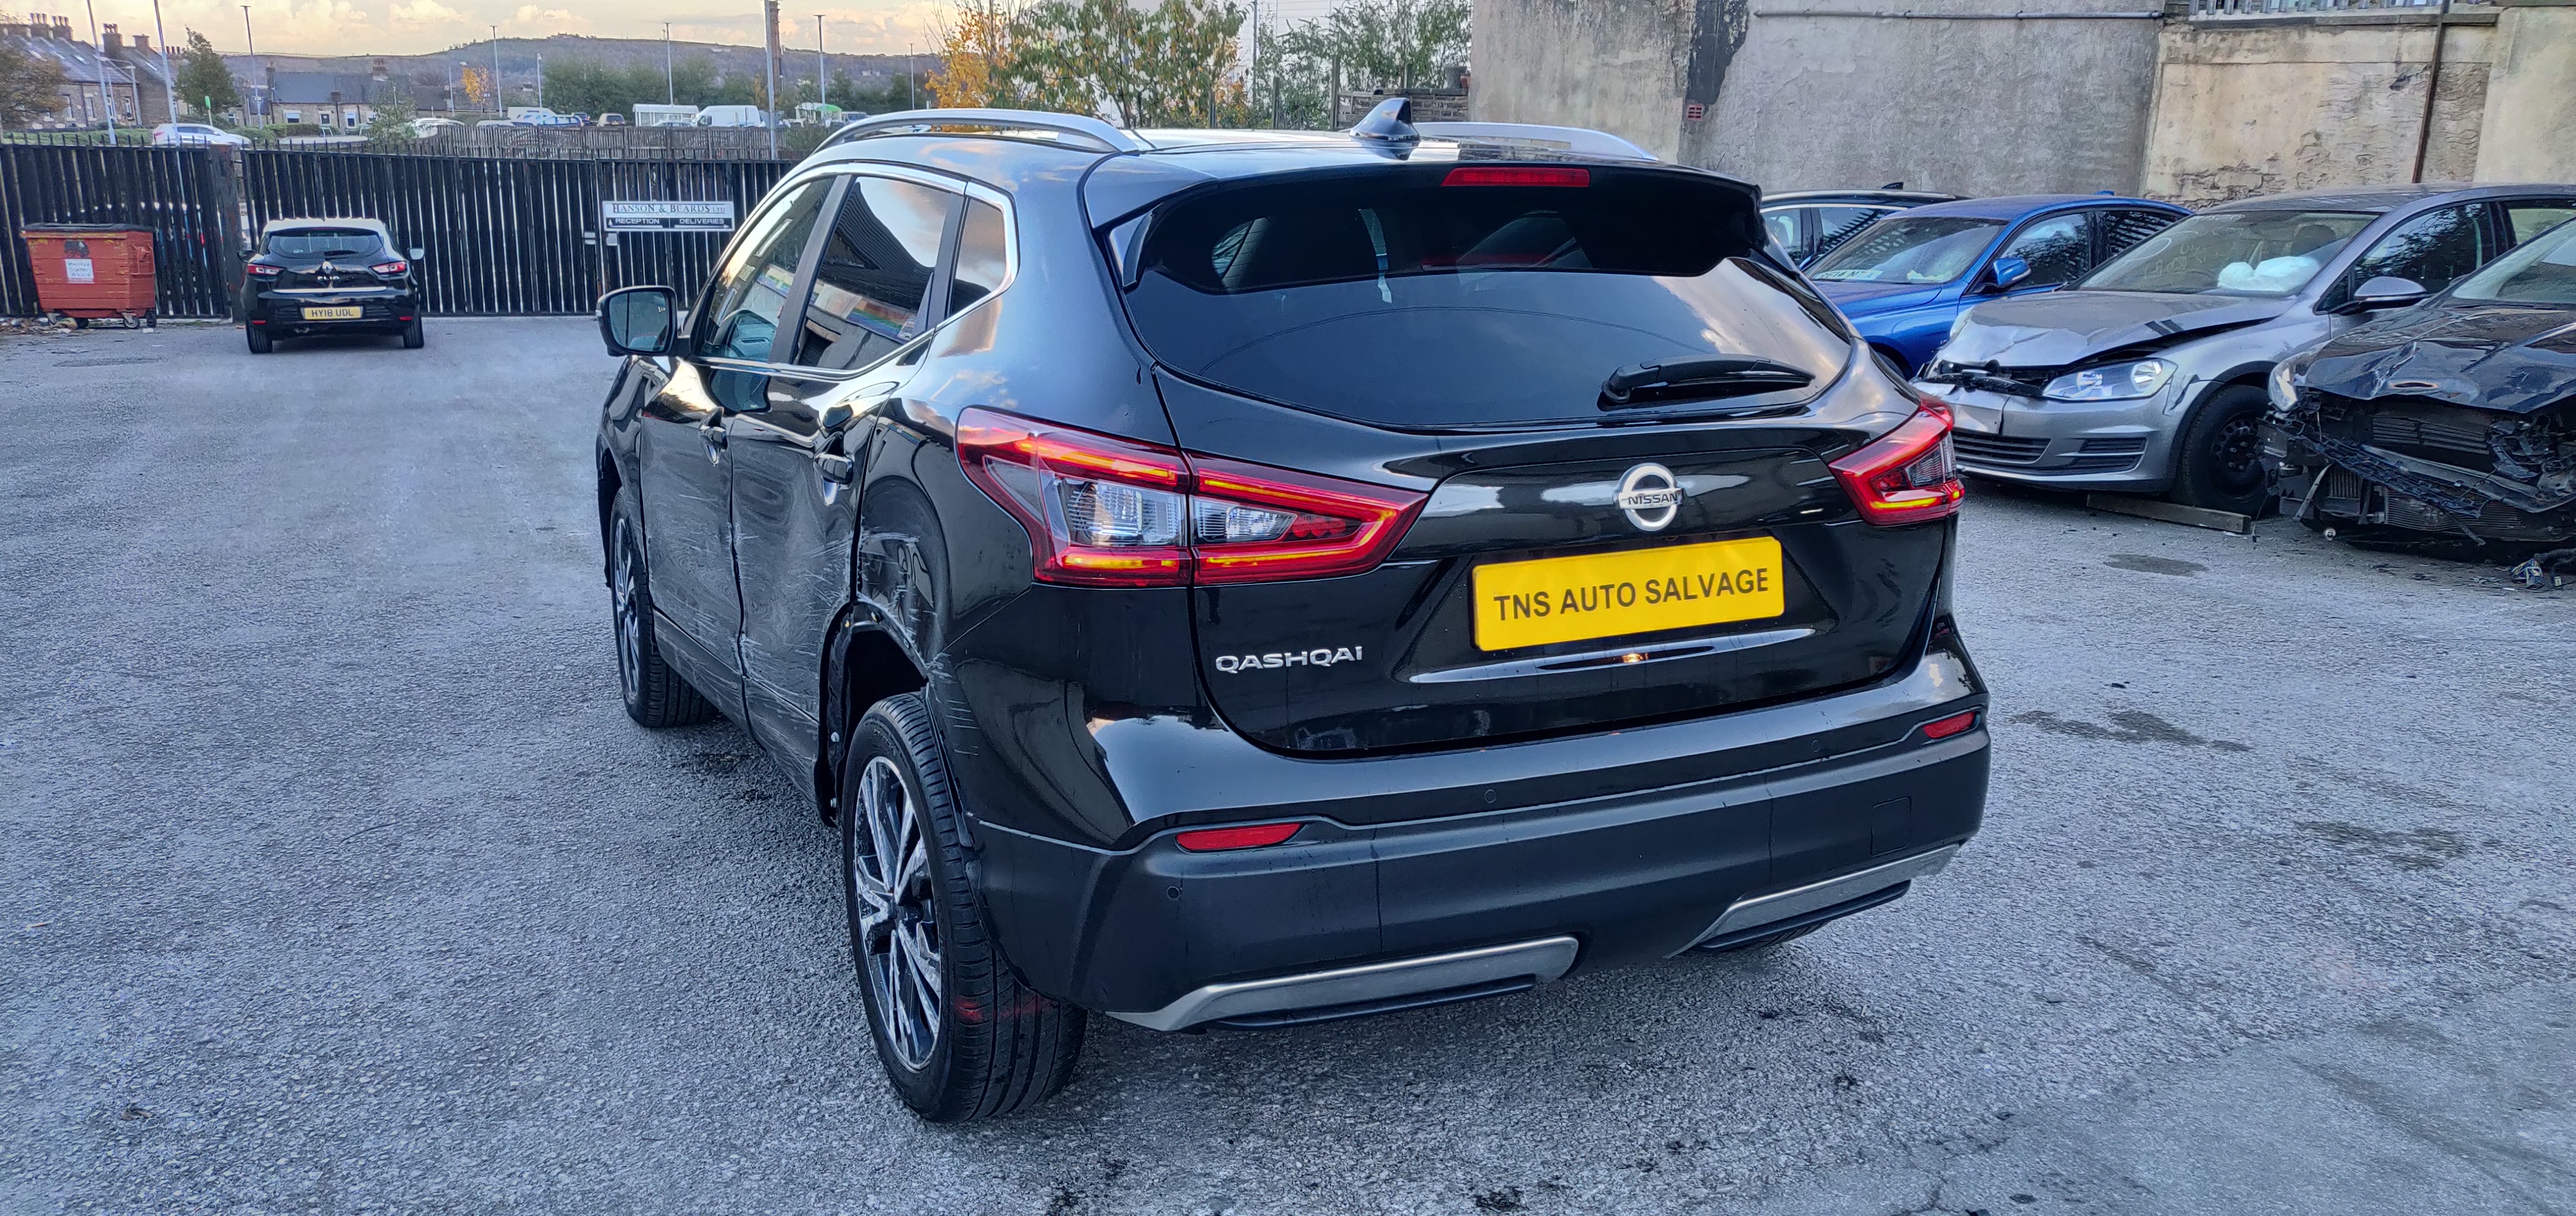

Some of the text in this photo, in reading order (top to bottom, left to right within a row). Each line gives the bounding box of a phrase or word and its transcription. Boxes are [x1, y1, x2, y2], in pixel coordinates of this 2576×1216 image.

[613, 203, 655, 213] HANSON
[659, 204, 666, 212] &
[670, 203, 711, 213] BEARDS
[1628, 493, 1678, 505] NISSAN
[1494, 568, 1768, 621] TNS AUTO SALVAGE
[1215, 646, 1363, 673] QASHQAI
